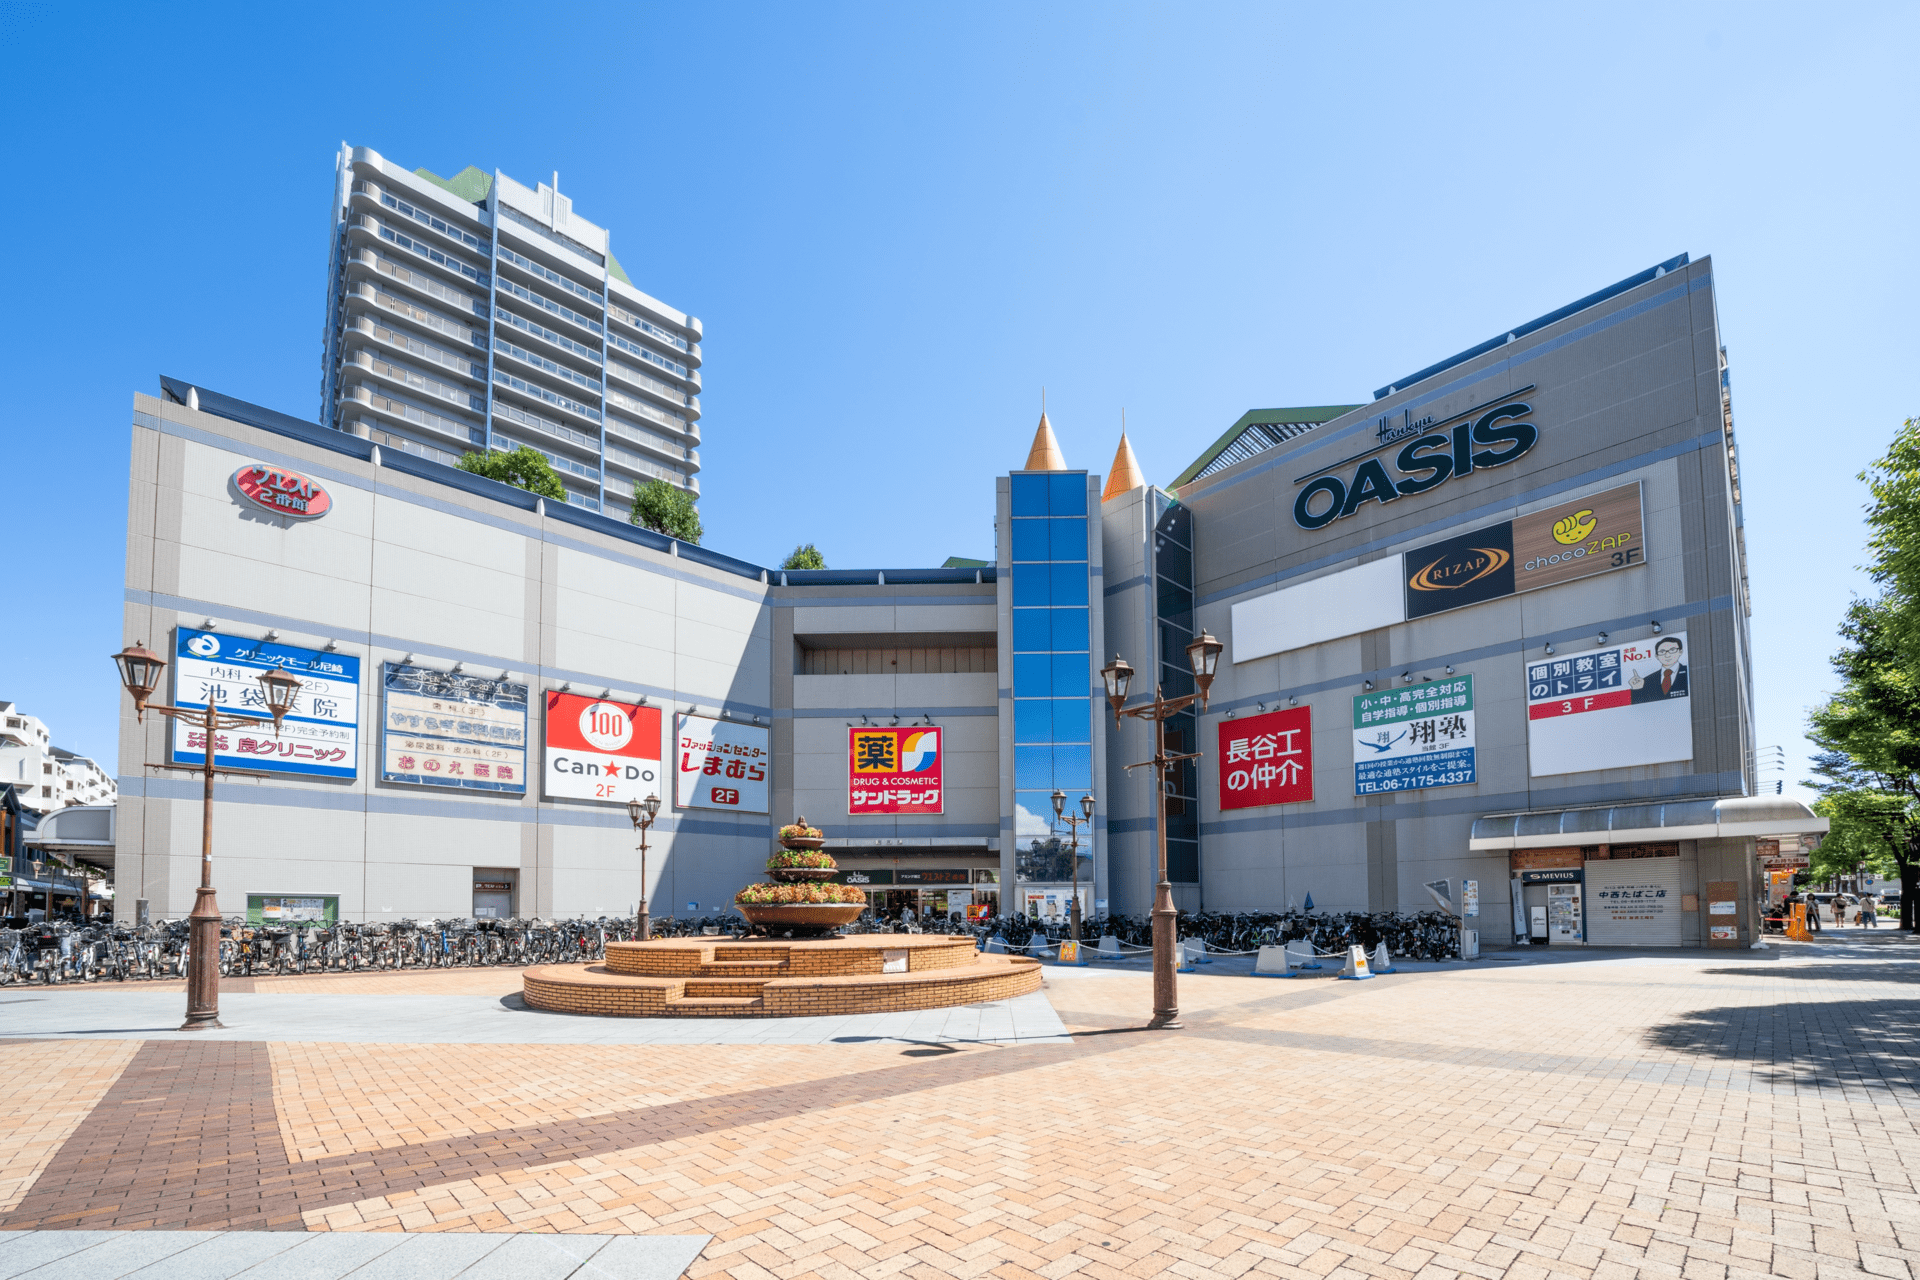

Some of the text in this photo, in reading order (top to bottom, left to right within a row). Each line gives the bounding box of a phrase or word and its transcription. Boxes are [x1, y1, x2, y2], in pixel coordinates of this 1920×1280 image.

[1375, 408, 1436, 444] Hankyu
[1293, 402, 1538, 531] OASIS
[252, 465, 321, 498] ウエスト
[1524, 532, 1631, 571] chocoZAP
[1610, 547, 1640, 568] 3F
[1433, 557, 1485, 581] RIZAP
[234, 648, 344, 674] クリニックモール尼崎
[1531, 653, 1618, 681] 個別教室
[1623, 650, 1651, 663] No.1
[1360, 681, 1467, 710] 小・中・高完全対応
[1531, 670, 1618, 697] のトライ
[1361, 694, 1467, 723] 自学指導・個別指導
[590, 711, 623, 737] 100
[1408, 714, 1467, 746] 翔塾
[237, 738, 347, 762] 良クリニック
[681, 737, 767, 758] ファッションセンター
[1226, 728, 1303, 764] 長谷工
[1377, 731, 1390, 744] 翔
[1438, 742, 1450, 750] 3F
[857, 735, 894, 770] 薬
[398, 755, 513, 780] おのえ医院
[680, 752, 767, 782] しまむら
[1227, 759, 1304, 791] の仲介
[595, 783, 616, 798] 2F
[853, 777, 939, 786] DRUG & COSMETIC
[1358, 770, 1473, 793] TEL:06-7175-4337
[715, 789, 735, 803] 2F
[852, 789, 940, 806] サンドラッグ
[847, 875, 870, 884] OASIS
[1541, 872, 1574, 880] MEVIUS
[1599, 889, 1667, 899] 中西たばこ店
